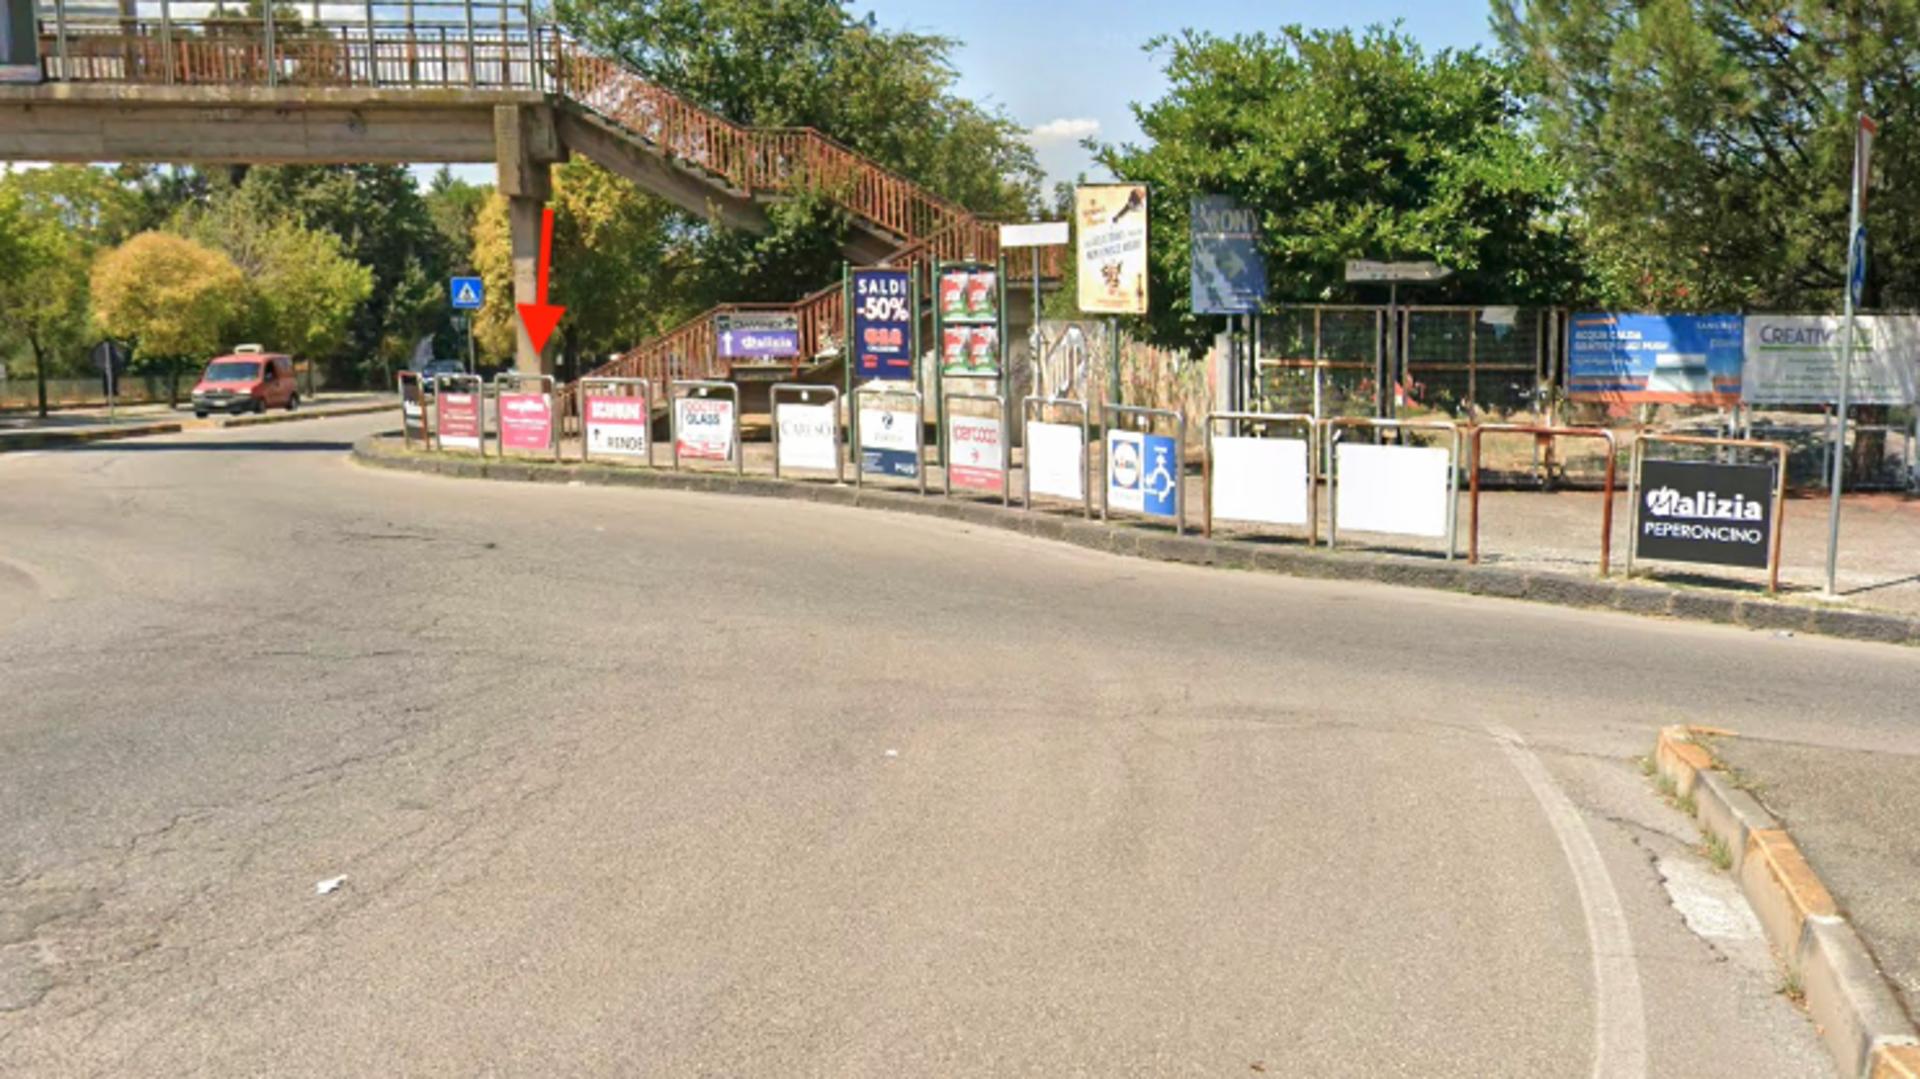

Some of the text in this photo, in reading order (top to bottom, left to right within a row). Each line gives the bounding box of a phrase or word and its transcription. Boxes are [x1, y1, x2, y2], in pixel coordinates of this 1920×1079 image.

[858, 278, 907, 295] SALDI
[857, 297, 909, 320] -50%
[1645, 485, 1762, 522] Malizia
[1644, 522, 1763, 544] PEPERONCINO
